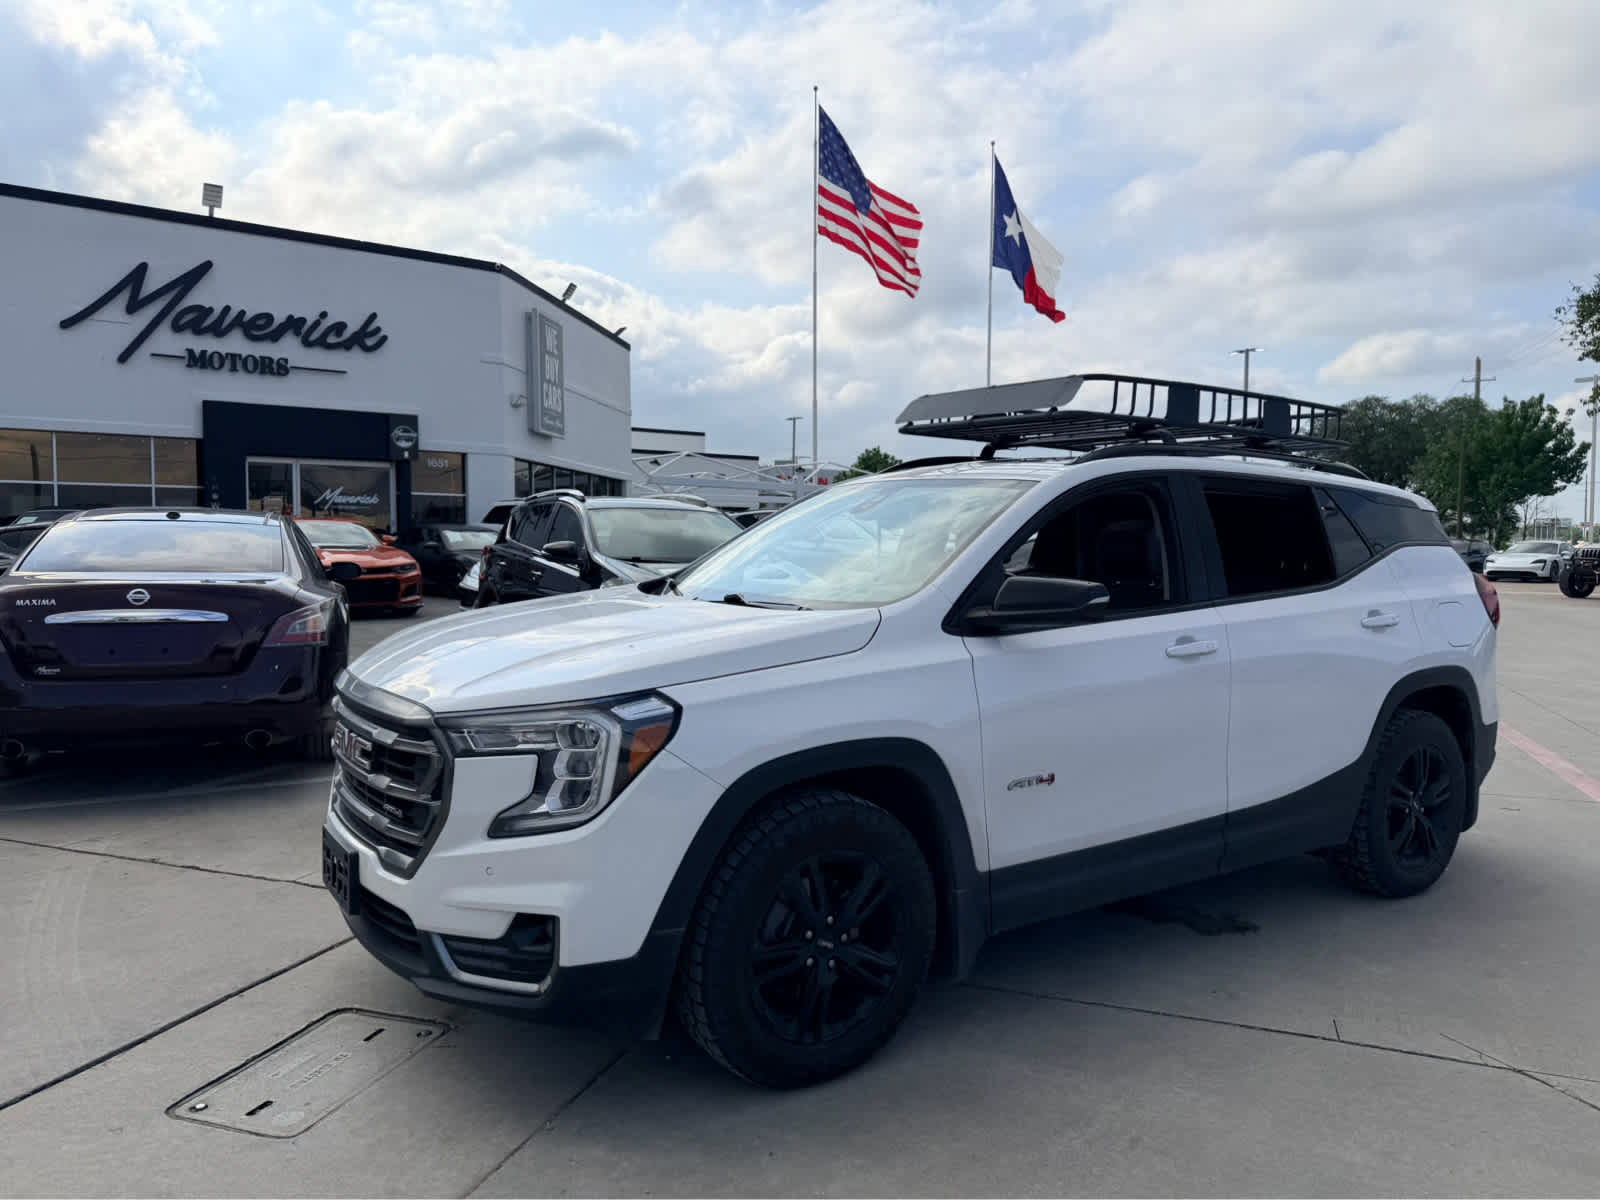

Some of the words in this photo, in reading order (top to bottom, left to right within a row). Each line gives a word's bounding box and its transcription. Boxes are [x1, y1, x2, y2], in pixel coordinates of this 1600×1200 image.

[60, 260, 388, 363] Maverick
[545, 324, 558, 355] WE
[185, 348, 290, 376] MOTORS
[545, 354, 559, 384] BUY
[543, 382, 561, 412] CARS
[314, 486, 380, 510] Maverick
[16, 599, 57, 607] MAXIMA
